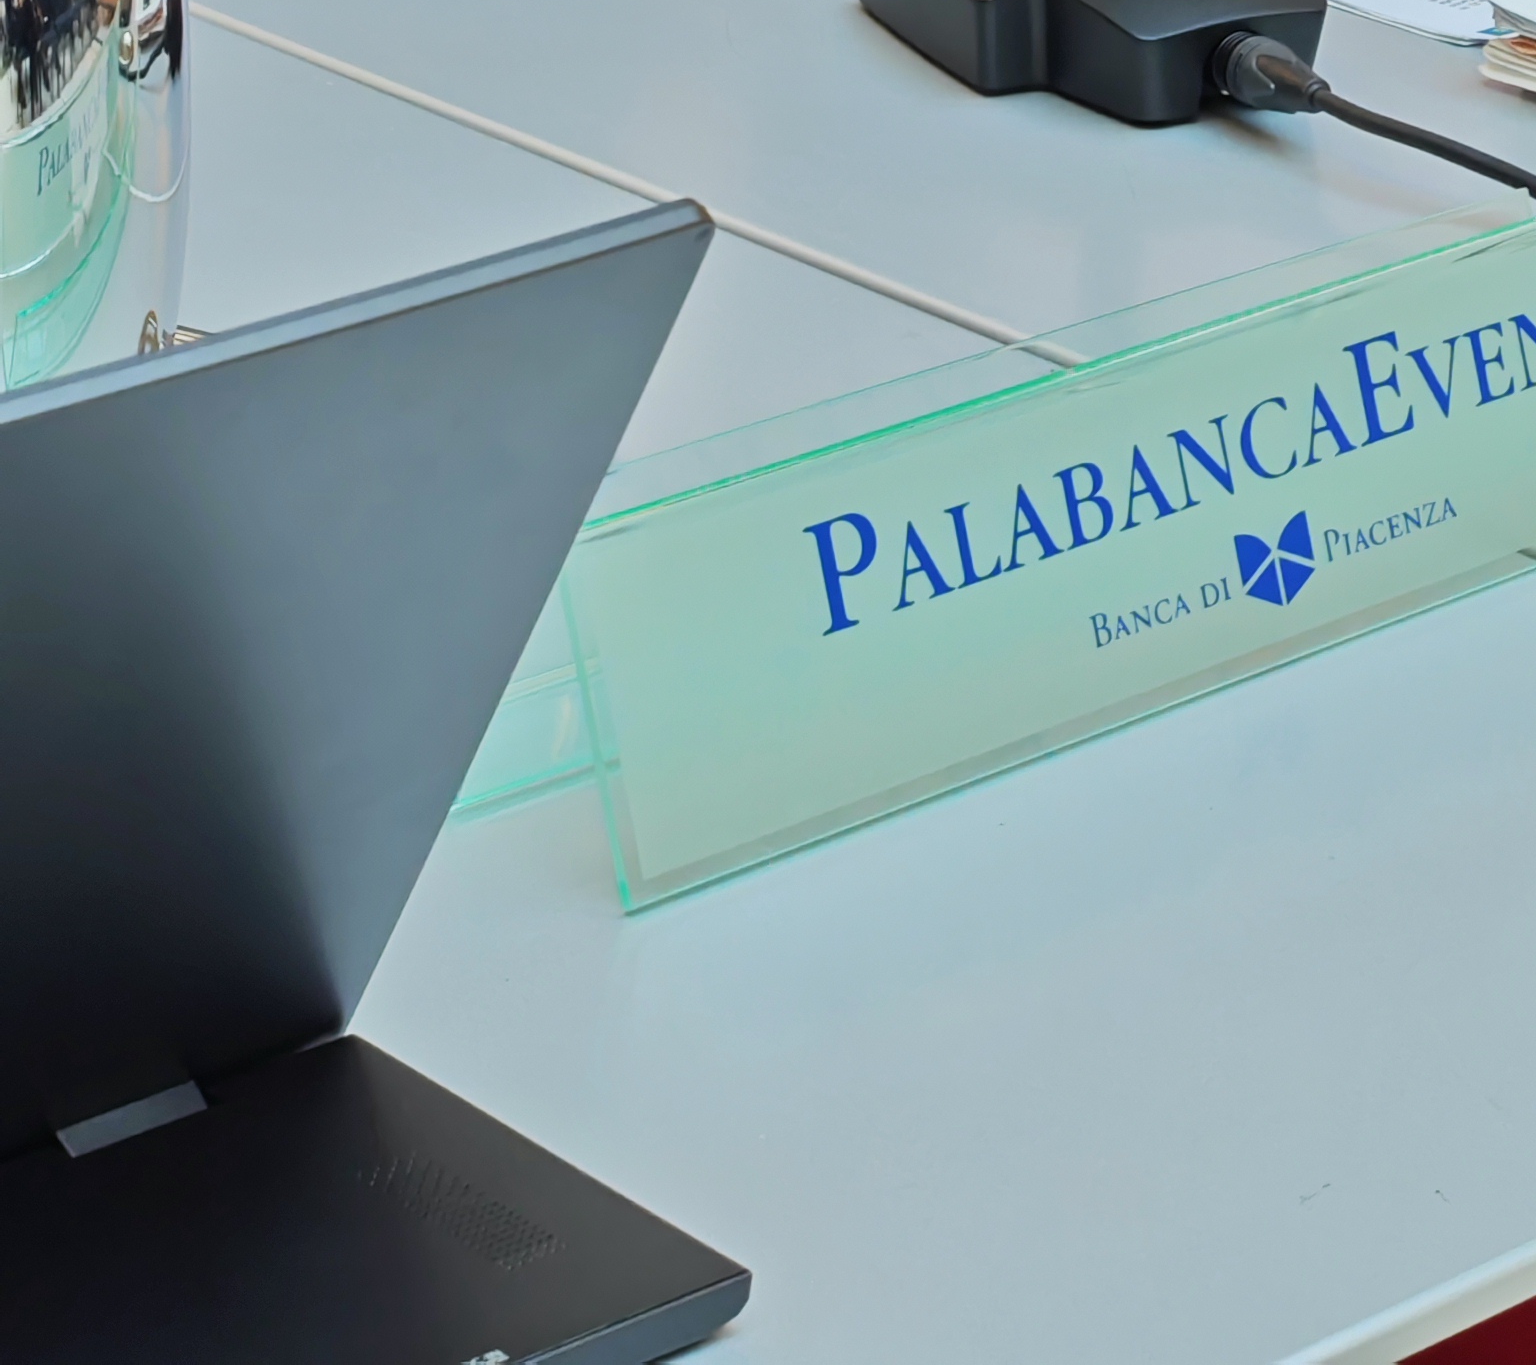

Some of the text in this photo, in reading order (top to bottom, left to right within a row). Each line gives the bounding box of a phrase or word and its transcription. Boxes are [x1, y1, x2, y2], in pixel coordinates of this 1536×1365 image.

[1088, 496, 1459, 649] BANCA DI PIACENZA
